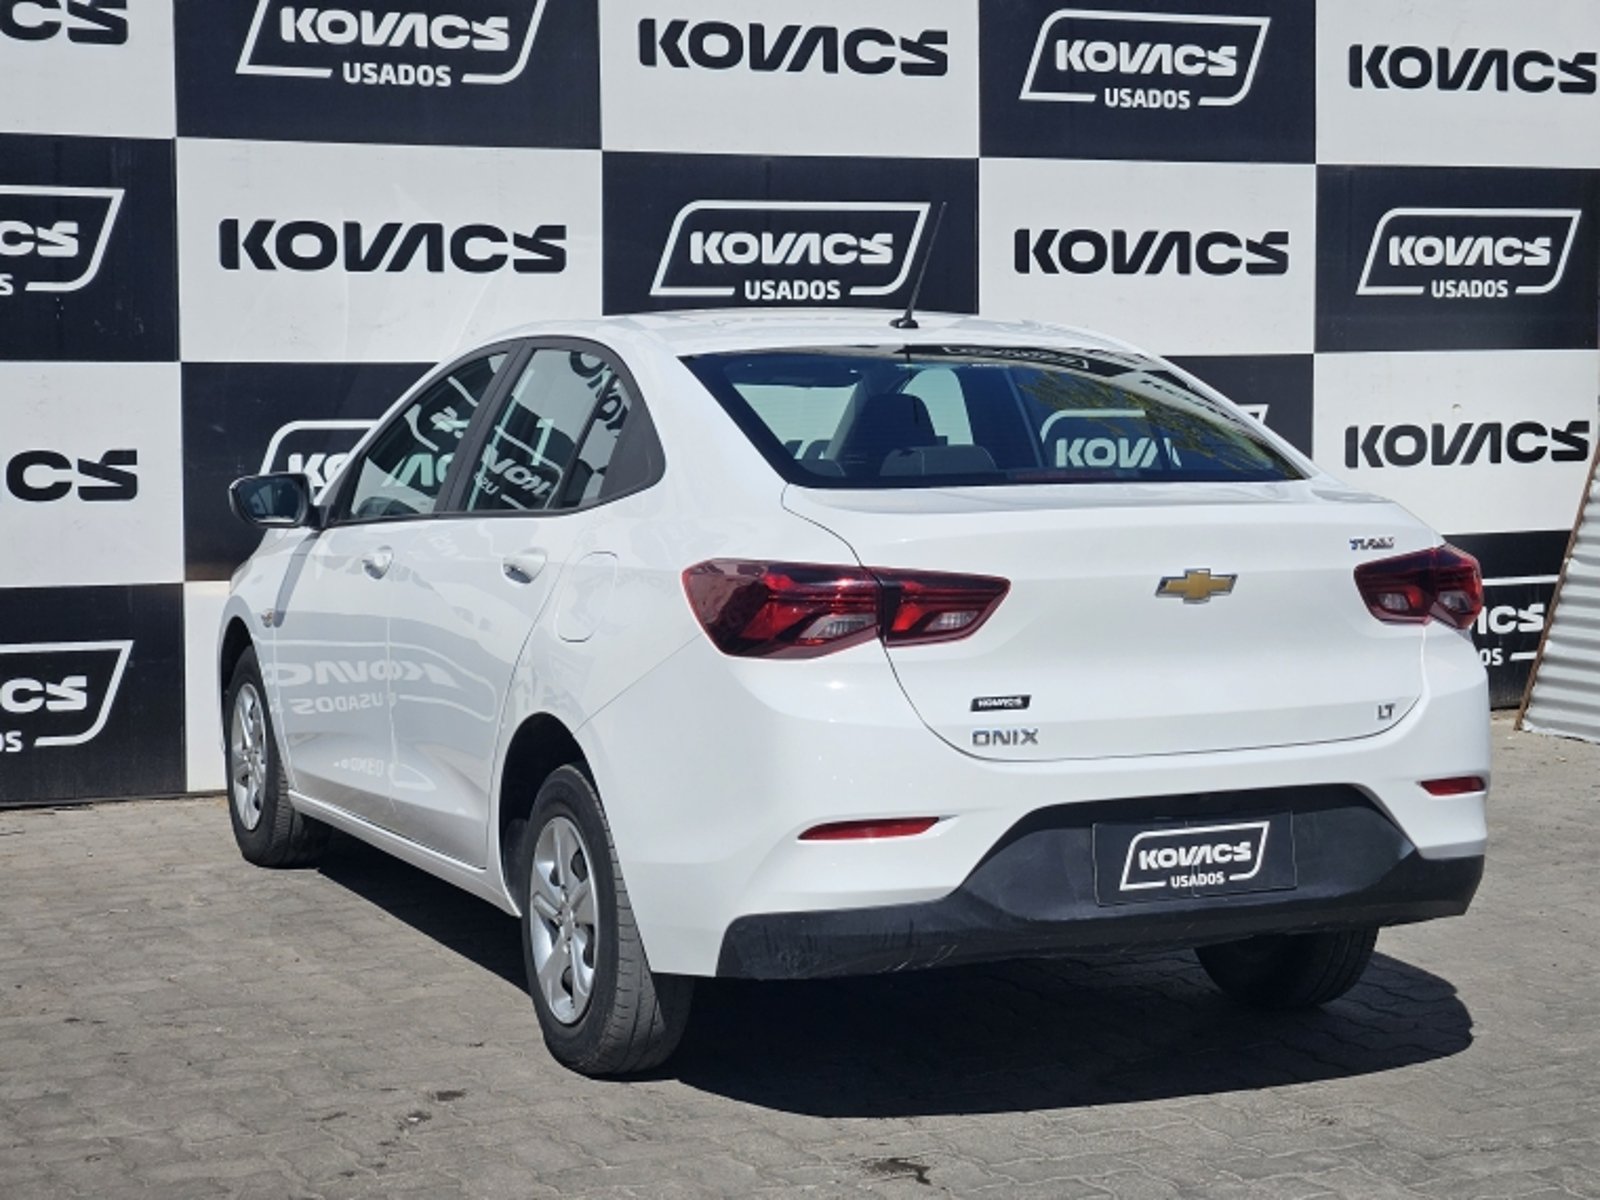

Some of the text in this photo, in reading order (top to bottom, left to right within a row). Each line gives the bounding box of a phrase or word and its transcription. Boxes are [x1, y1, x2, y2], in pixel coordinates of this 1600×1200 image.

[280, 8, 510, 51] KOVACS
[638, 18, 948, 76] KOVACS
[1055, 40, 1237, 76] KOVACS
[343, 62, 452, 87] USADOS
[1349, 44, 1597, 94] KOVACS
[1104, 88, 1191, 109] USADOS
[219, 218, 567, 273] KOVACS
[690, 232, 893, 264] KOVACS
[1014, 229, 1289, 276] KOVACS
[1389, 236, 1551, 267] KOVACS
[744, 280, 841, 300] USADOS
[1431, 280, 1508, 298] USADOS
[1056, 437, 1181, 468] KOVA
[1344, 420, 1590, 469] KOVACS
[1378, 703, 1396, 720] LT
[973, 728, 1039, 746] ONIX
[1138, 841, 1251, 870] KOVACS
[1170, 871, 1225, 888] USADOS
